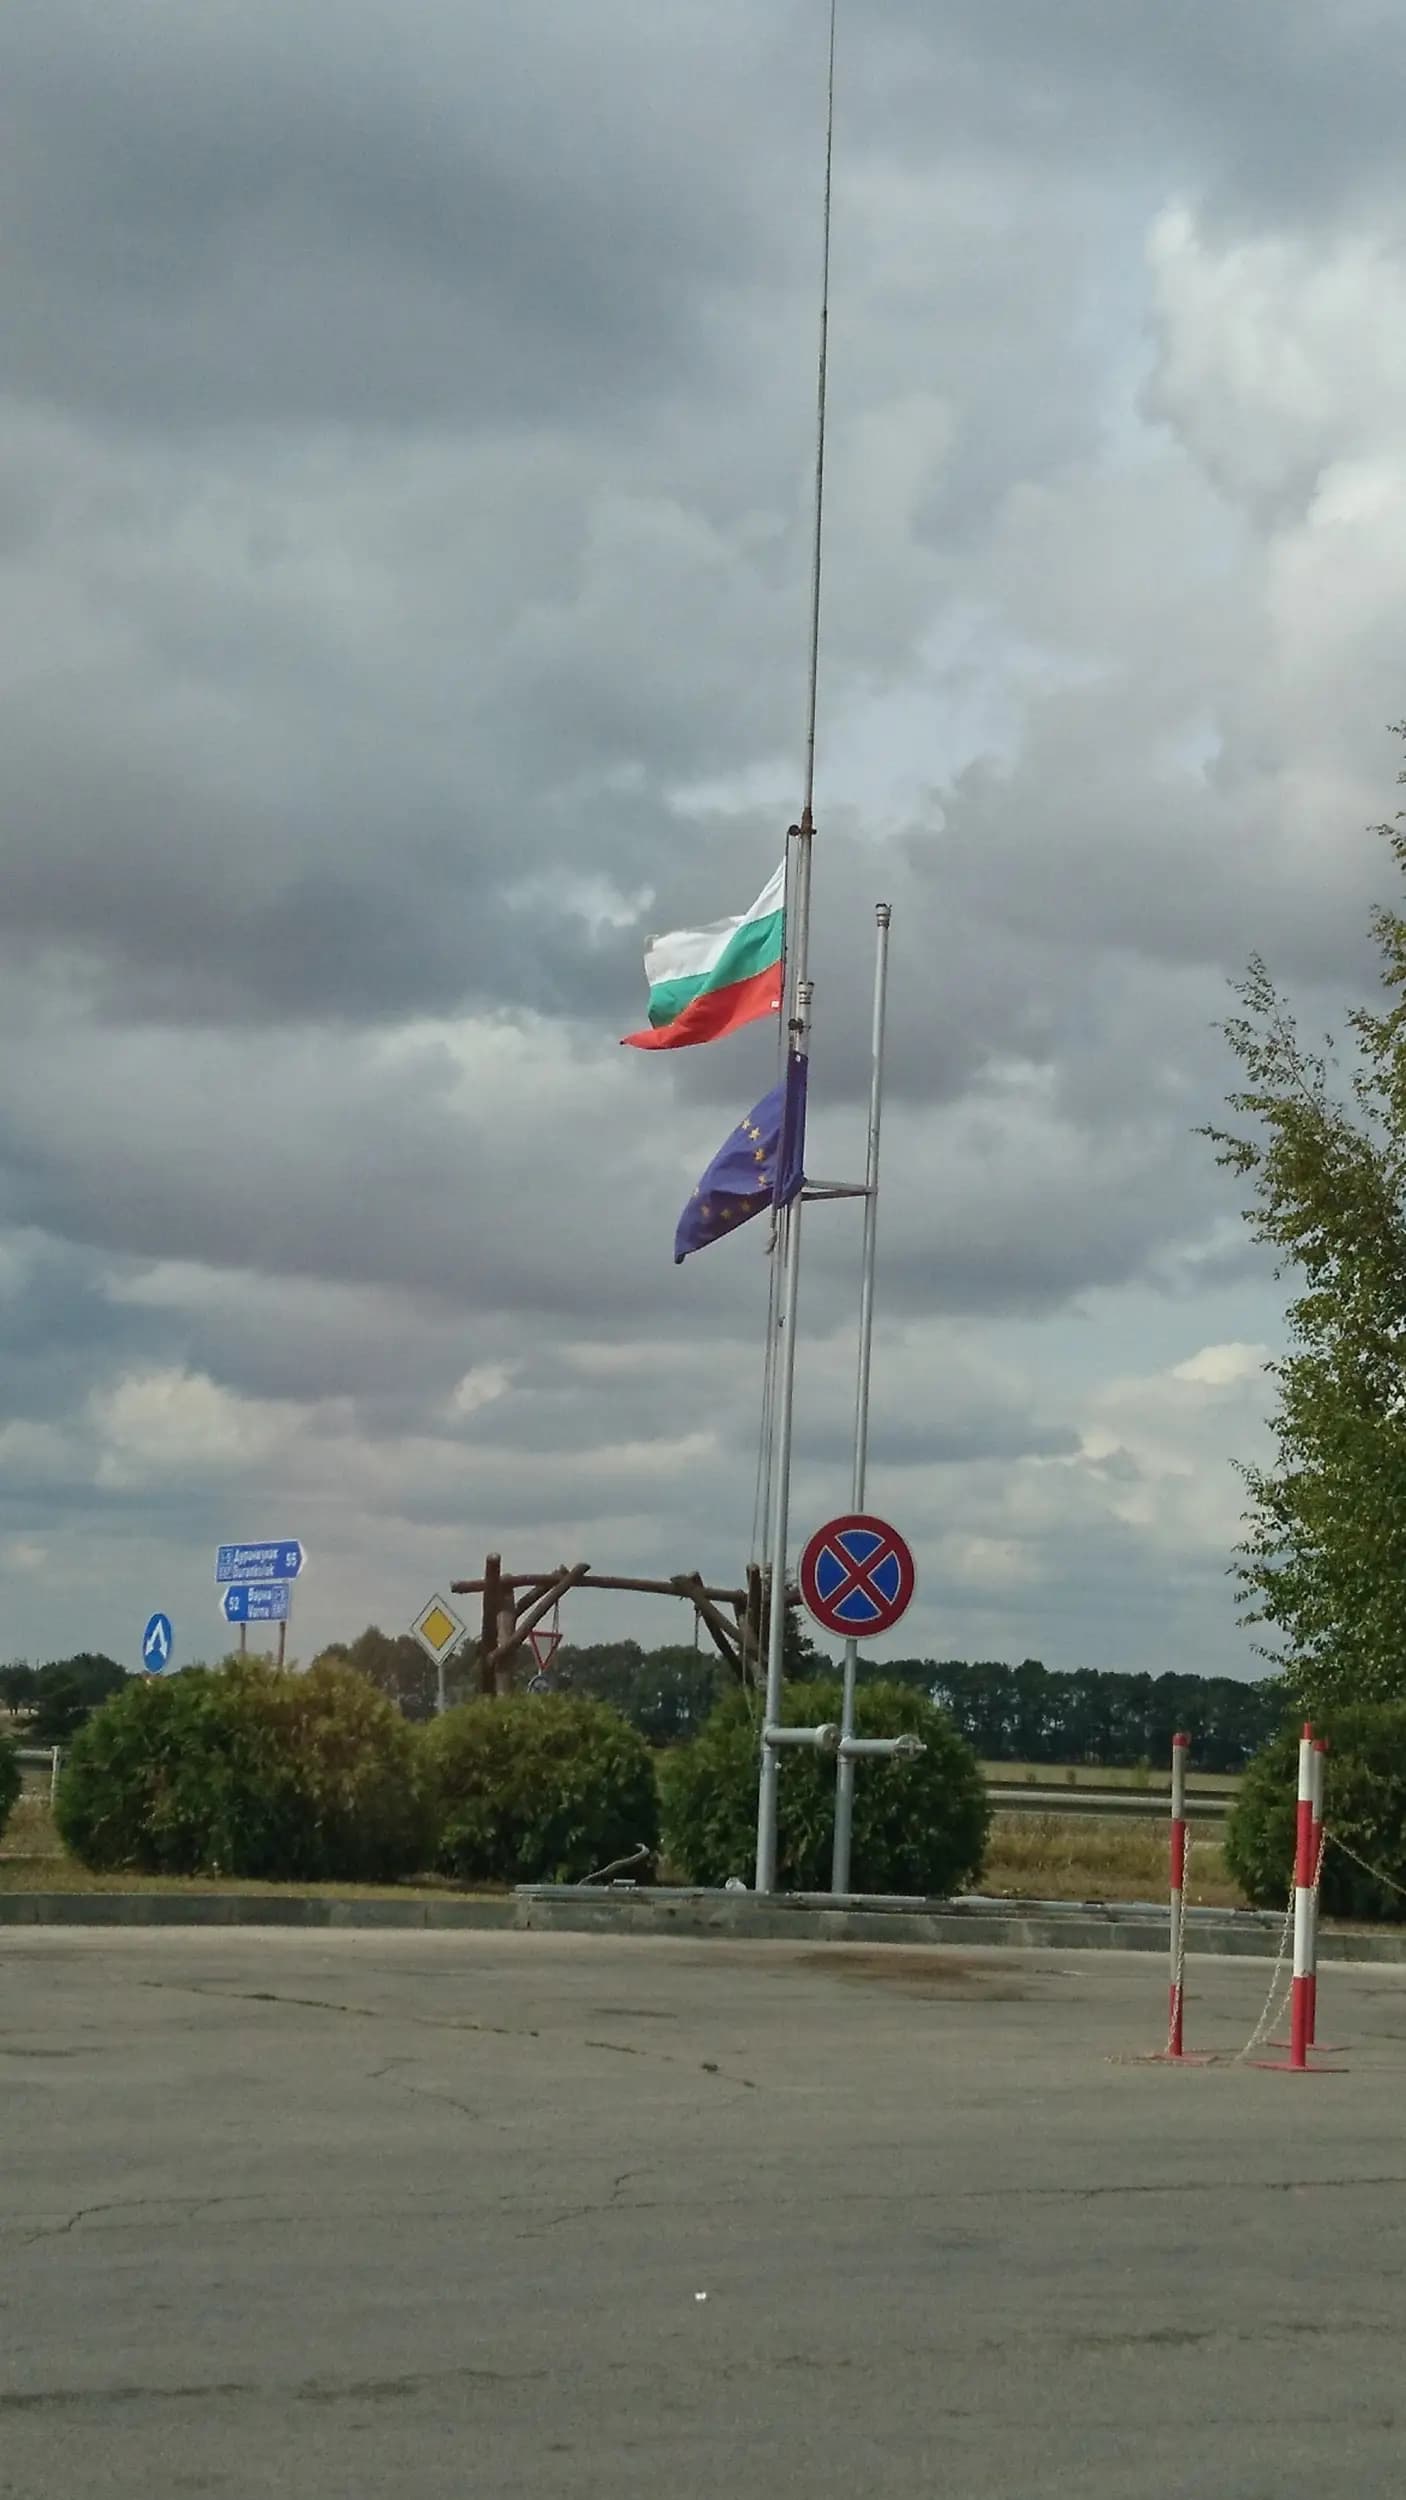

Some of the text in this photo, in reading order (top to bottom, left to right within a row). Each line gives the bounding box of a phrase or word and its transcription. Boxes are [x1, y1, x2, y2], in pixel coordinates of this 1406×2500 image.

[248, 1587, 272, 1604] Варна
[229, 1596, 240, 1611] 52
[248, 1604, 270, 1618] Varna
